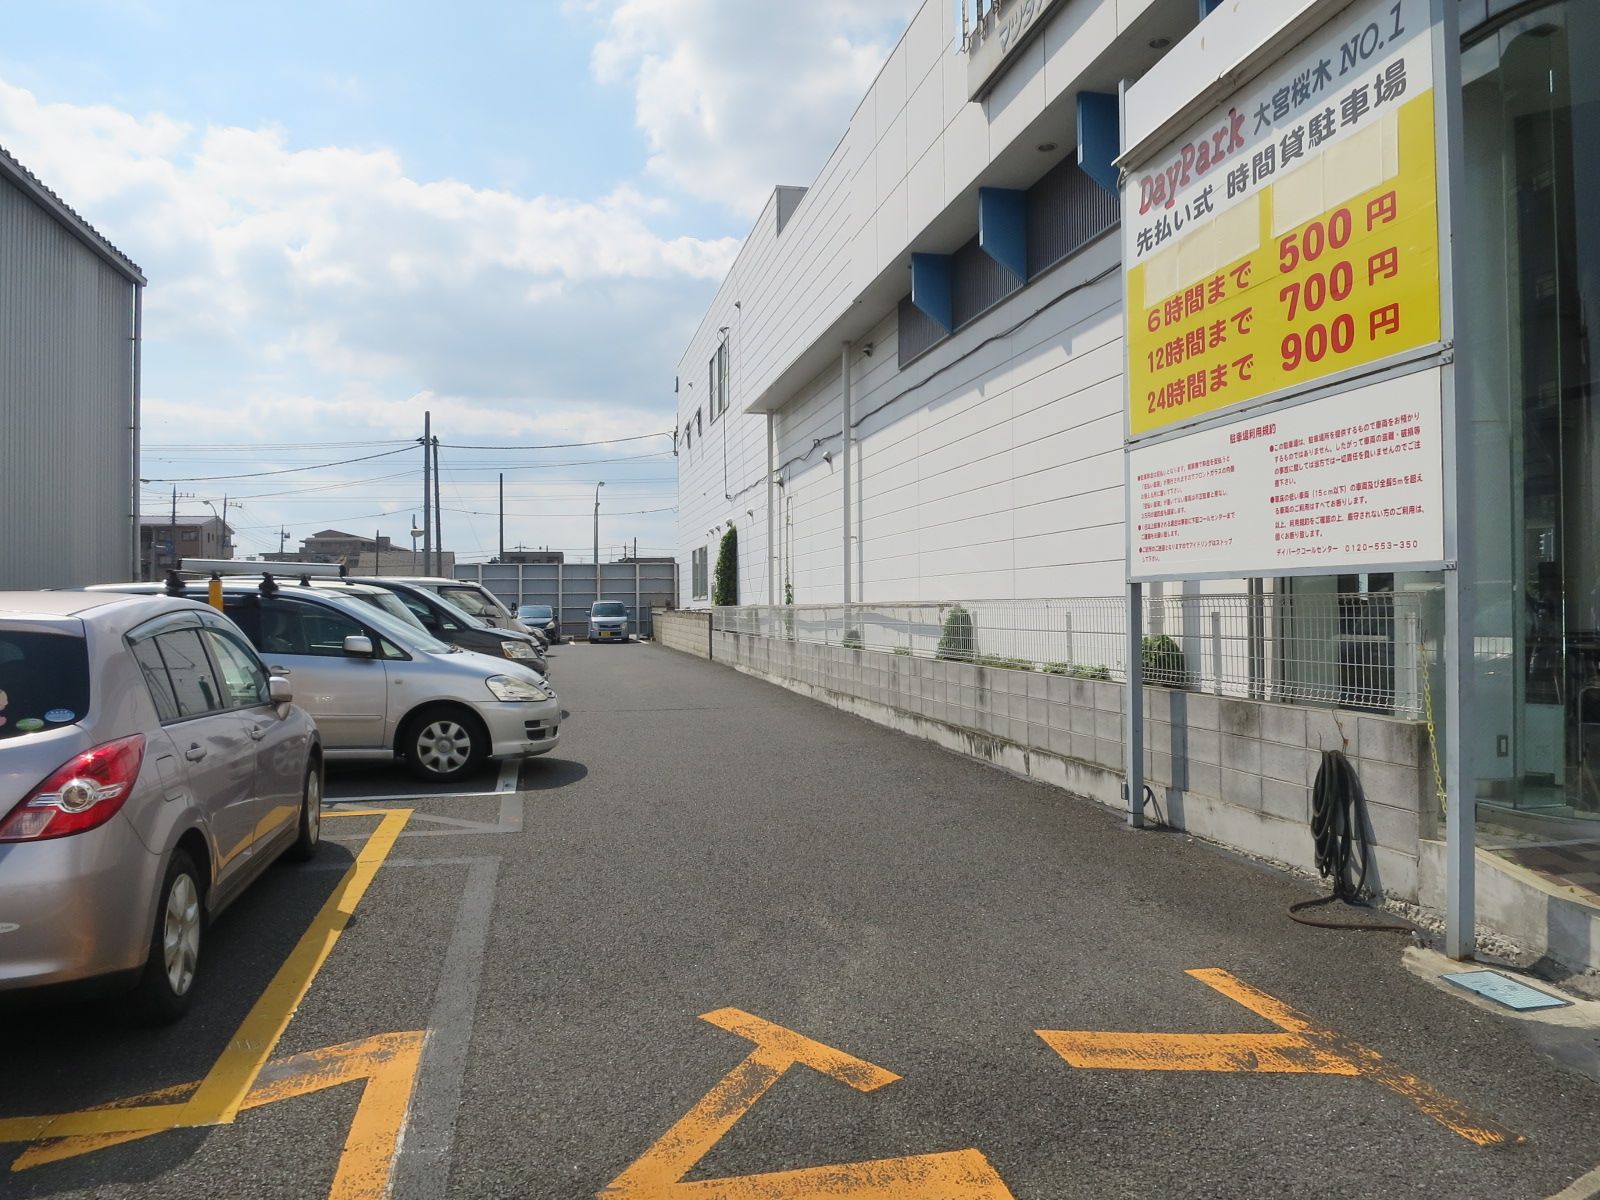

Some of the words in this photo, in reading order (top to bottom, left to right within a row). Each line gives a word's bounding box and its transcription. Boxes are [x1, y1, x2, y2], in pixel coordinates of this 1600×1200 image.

[1139, 108, 1246, 215] DayPark
[1254, 59, 1332, 135] 大宮桜木
[1339, 0, 1405, 76] NO.1
[1136, 185, 1214, 257] 先払い式
[1227, 58, 1407, 199] 時間貸駐車場
[1148, 261, 1252, 333] 6時間まで
[1148, 307, 1253, 373] 12時間まで
[1147, 353, 1254, 414] 24時間まで
[1345, 540, 1417, 552] 0120-553-350
